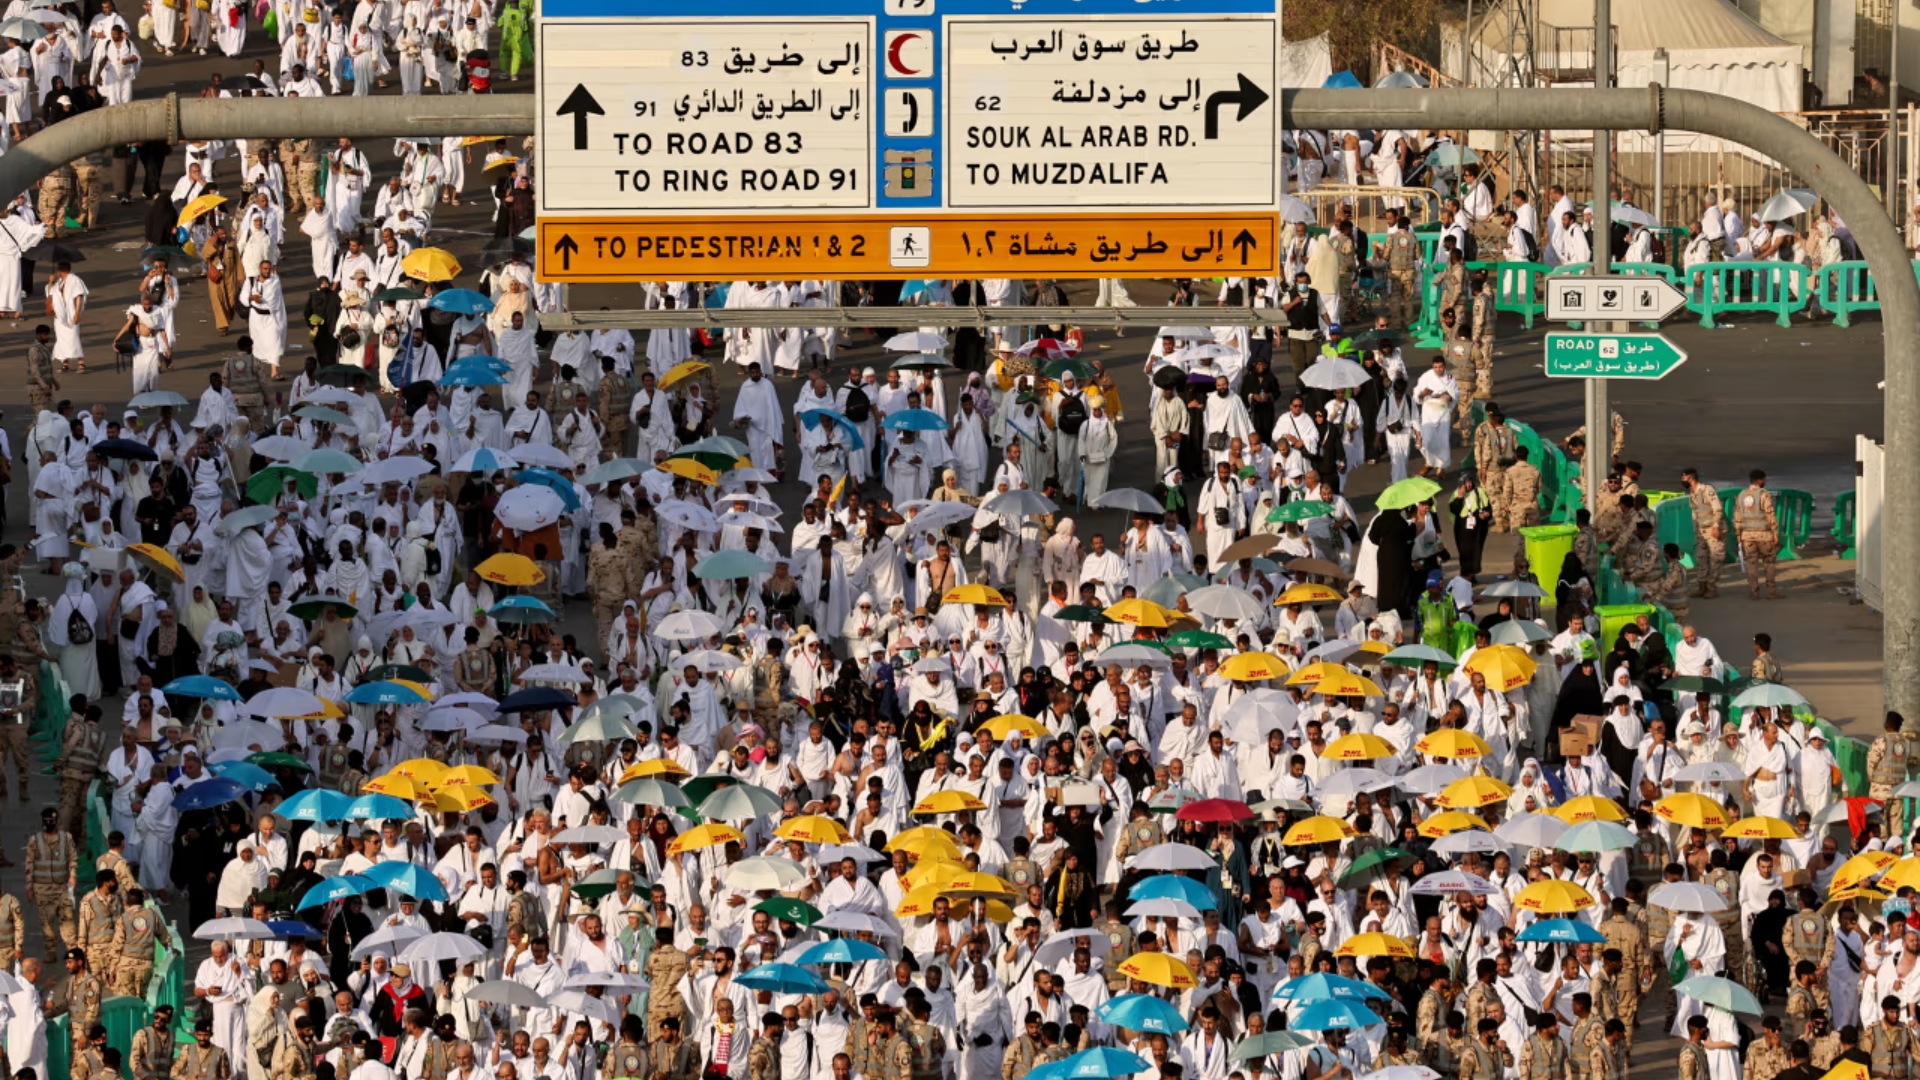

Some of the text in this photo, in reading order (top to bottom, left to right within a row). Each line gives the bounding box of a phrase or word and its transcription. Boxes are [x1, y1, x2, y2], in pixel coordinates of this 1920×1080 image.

[990, 29, 1199, 62] طريق سوق العرب
[681, 50, 709, 67] 83
[817, 42, 860, 75] إلى
[634, 88, 860, 122] إلى الطريق الدائري 91
[974, 78, 1201, 112] إلى مزدلفة 62
[613, 131, 803, 156] TO ROAD 83
[966, 125, 1197, 149] SOUK AL ARAB RD.
[614, 168, 856, 192] TO RING ROAD 91
[966, 162, 1168, 185] TO MUZDALIFA
[593, 236, 626, 259] TO
[637, 235, 801, 258] PEDESTRIAN
[827, 234, 842, 258] &
[850, 234, 866, 257] 2
[1009, 231, 1078, 257] مشاة
[1089, 230, 1169, 263] طريق
[1181, 229, 1224, 263] إلى
[1556, 339, 1616, 354] ROAD 62
[1623, 341, 1655, 354] طريق
[1595, 360, 1621, 372] سوق
